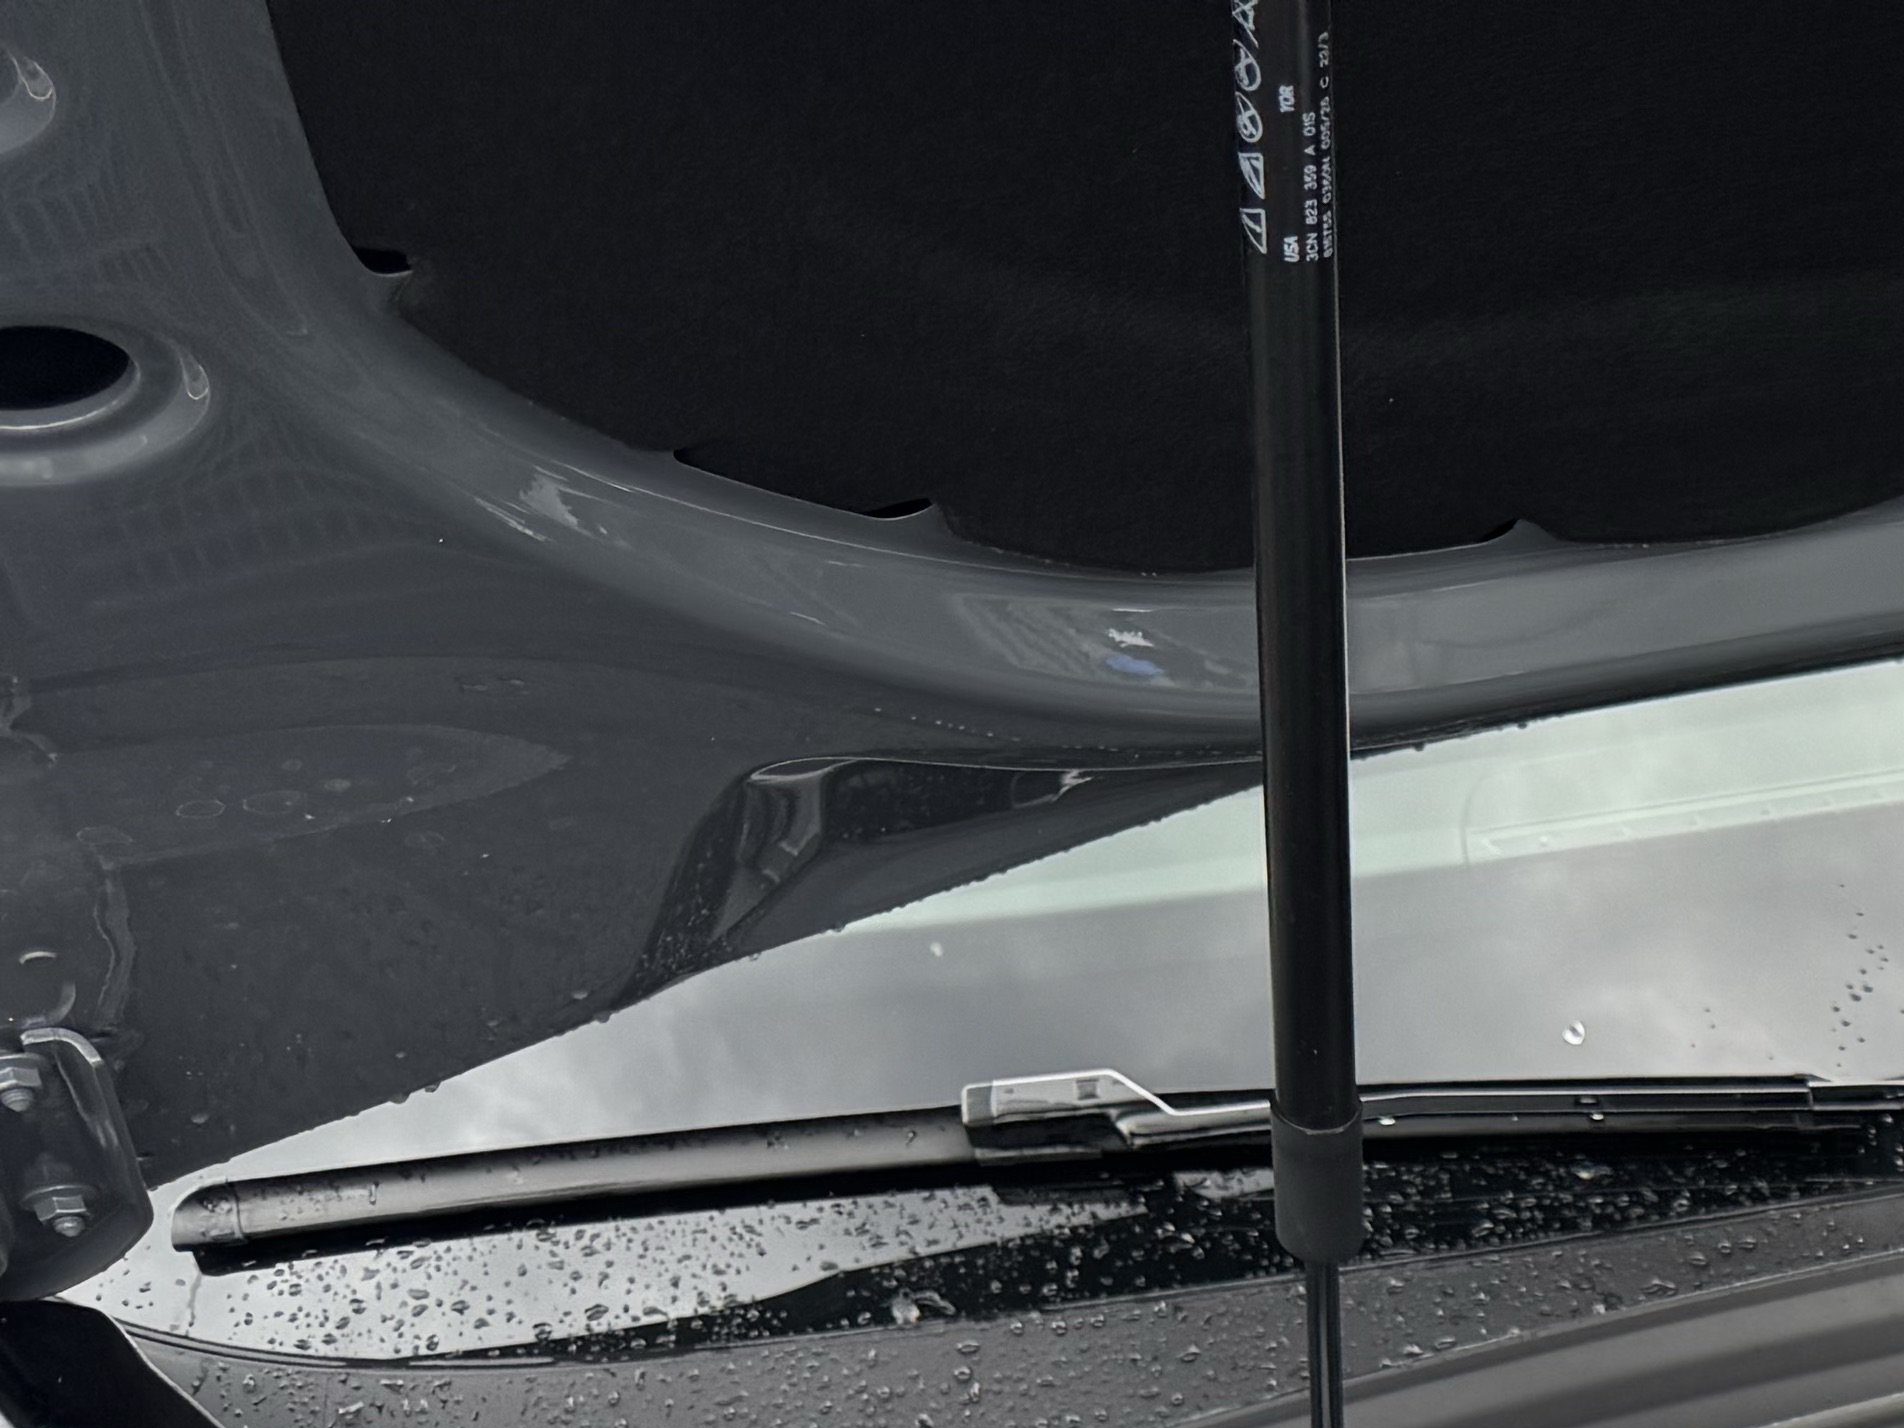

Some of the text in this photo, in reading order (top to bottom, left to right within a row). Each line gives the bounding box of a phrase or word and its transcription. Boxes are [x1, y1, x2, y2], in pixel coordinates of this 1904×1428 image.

[1303, 145, 1315, 155] A
[1305, 199, 1317, 224] 823
[1283, 235, 1299, 262] USA
[1306, 233, 1318, 261] 3CN
